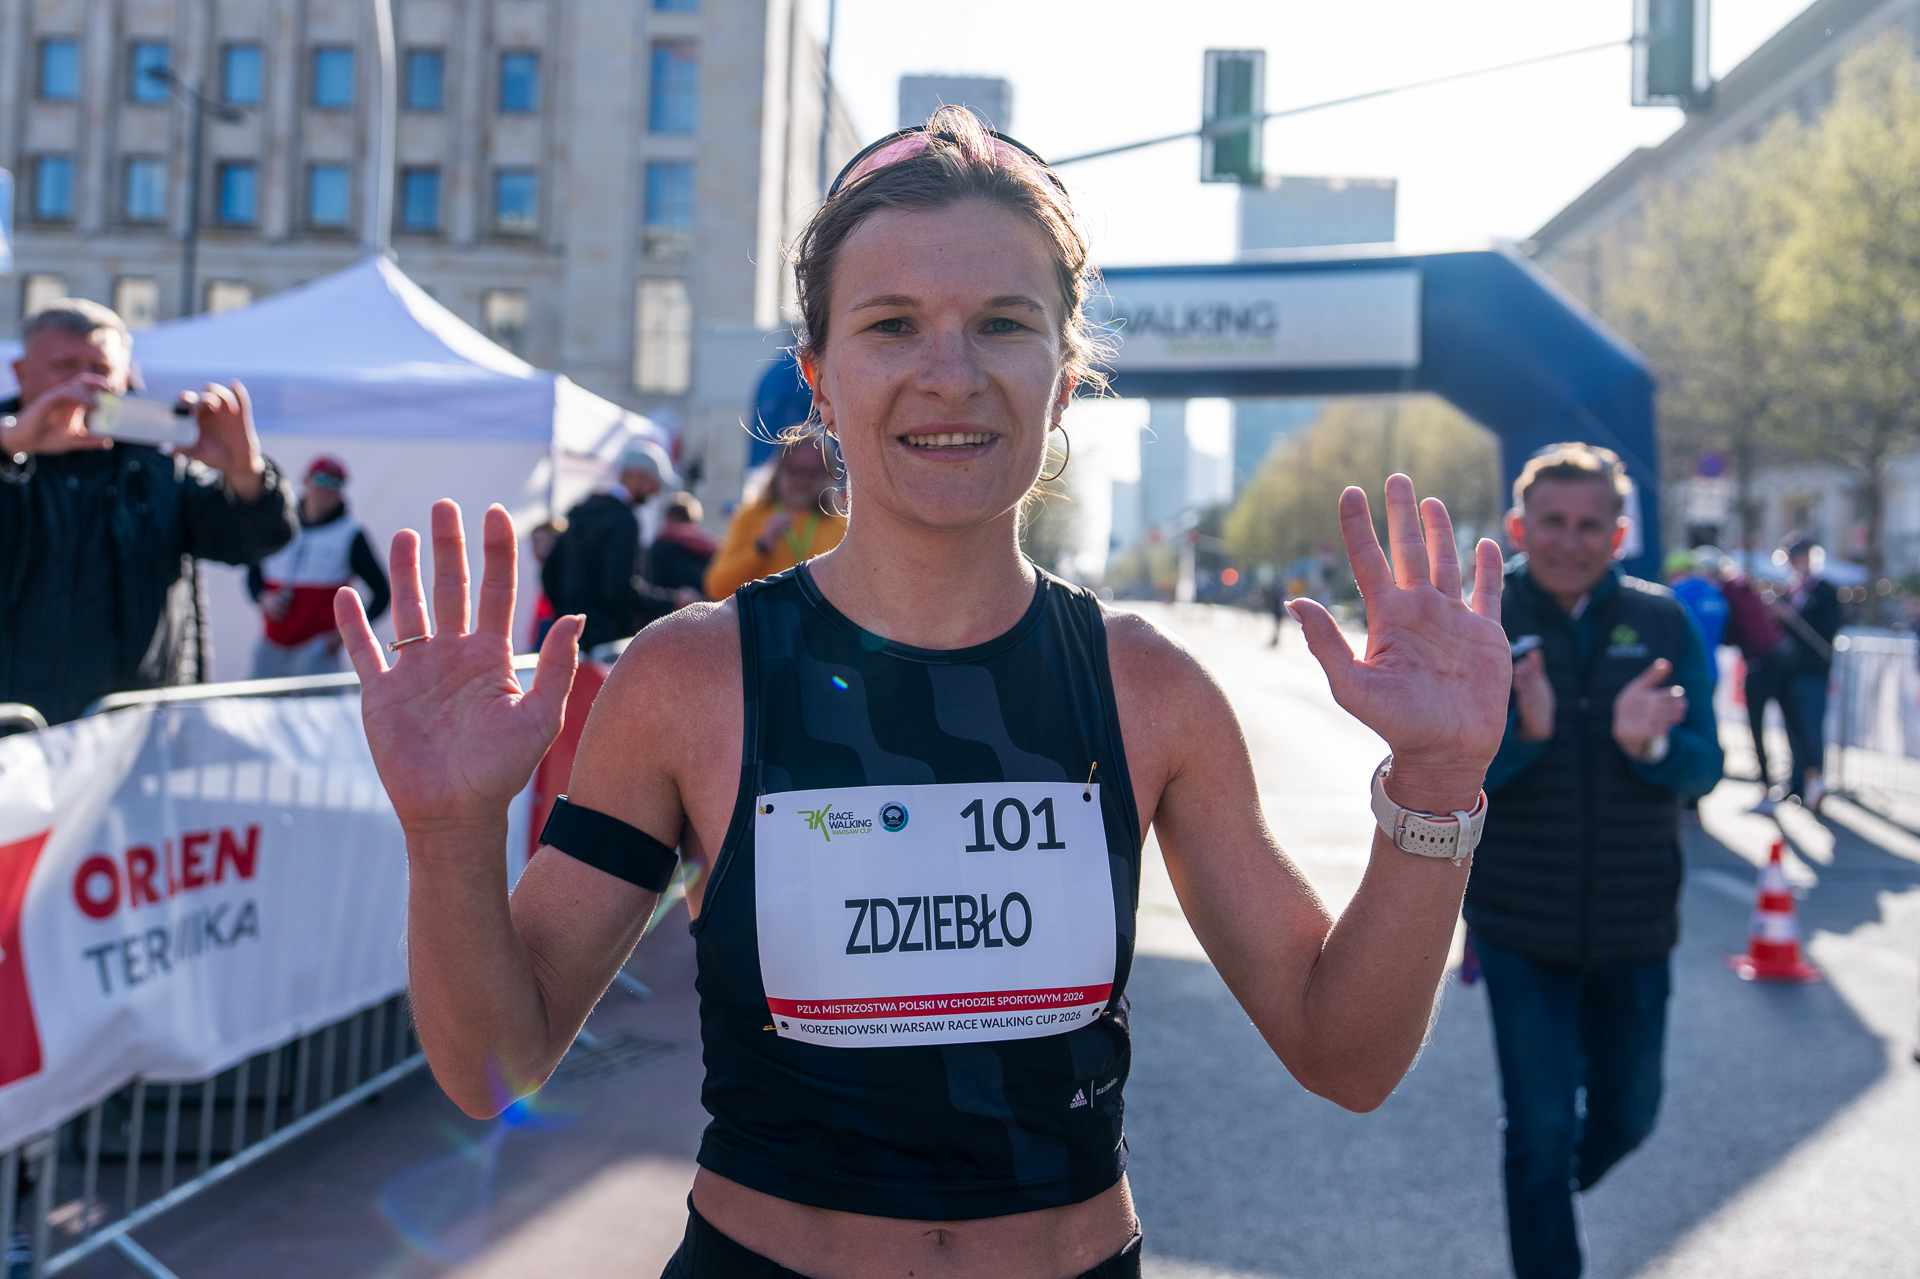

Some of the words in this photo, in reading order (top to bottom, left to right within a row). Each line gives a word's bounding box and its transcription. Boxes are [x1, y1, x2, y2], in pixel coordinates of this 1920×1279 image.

[829, 812, 854, 821] RACE
[829, 819, 872, 829] WALKING
[960, 797, 1066, 853] 101
[845, 891, 1032, 955] ZDZIEBŁO
[797, 1005, 821, 1014] PZLA
[823, 1002, 897, 1014] MISTRZOSTWA
[900, 1000, 935, 1011] POLSKI
[937, 1000, 948, 1009] W
[950, 997, 996, 1008] CHODZIE
[997, 993, 1061, 1006] SPORTOWYM
[1063, 992, 1084, 1001] 2026
[800, 1023, 887, 1035] KORZENIOWSKI
[895, 1021, 945, 1033] WARSAW
[948, 1019, 978, 1031] RACE
[981, 1015, 1033, 1029] WALKING
[1036, 1013, 1057, 1025] CUP
[1059, 1011, 1081, 1023] 2026
